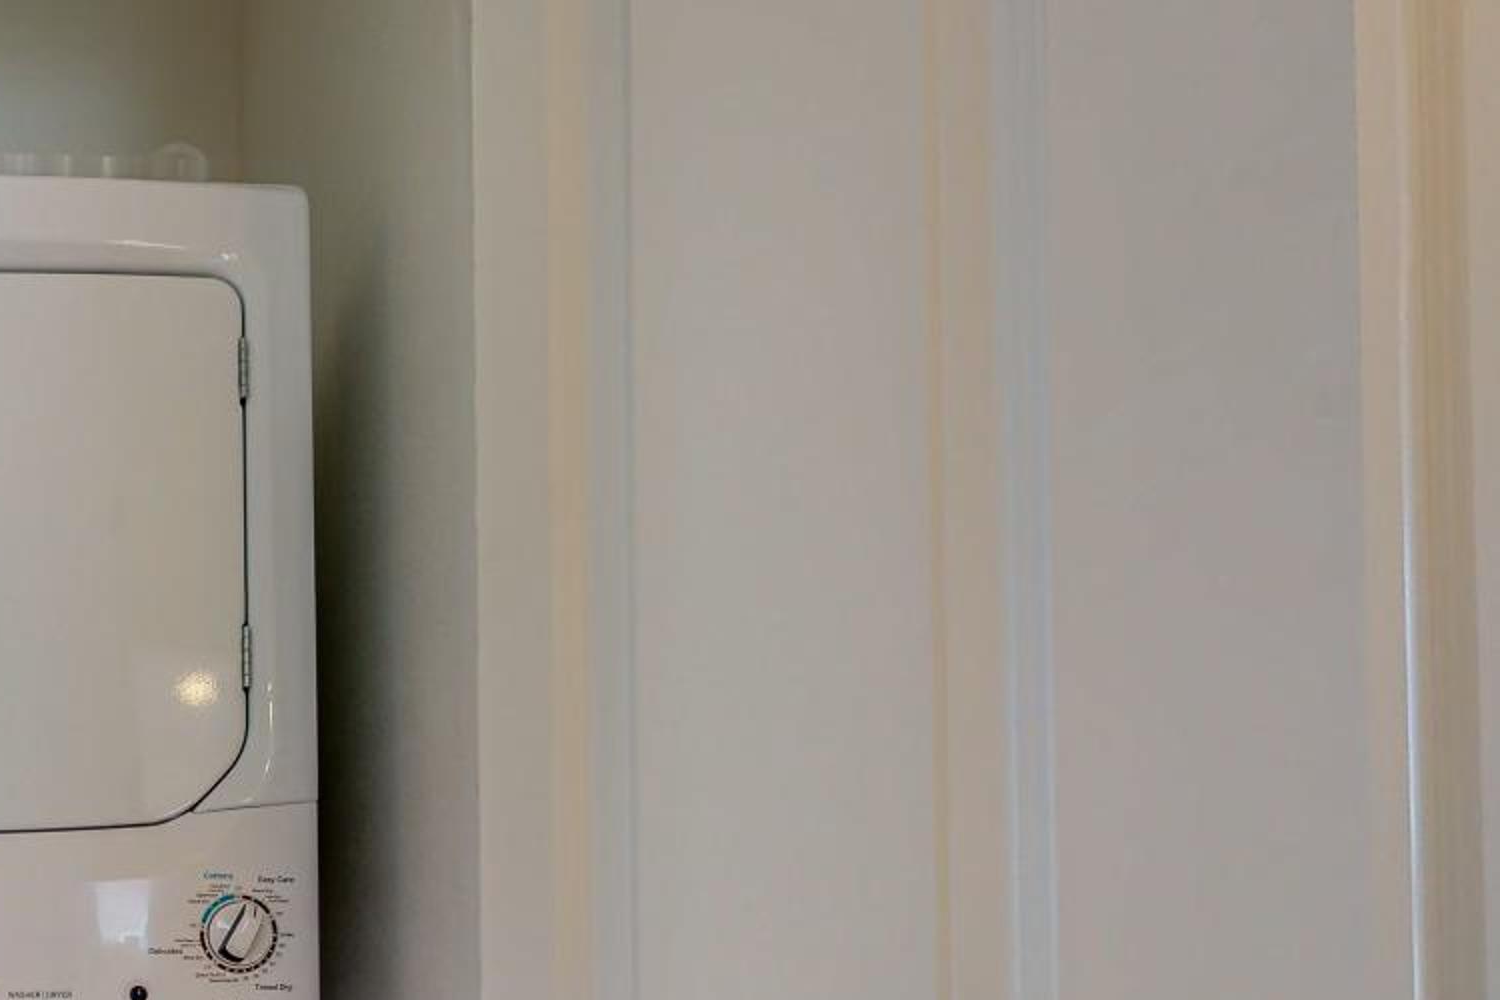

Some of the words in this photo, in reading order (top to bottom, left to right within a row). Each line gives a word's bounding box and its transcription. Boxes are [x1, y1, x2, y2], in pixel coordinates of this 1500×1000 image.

[258, 876, 275, 884] Easy
[255, 983, 278, 991] Timed
[279, 983, 292, 992] Dry
